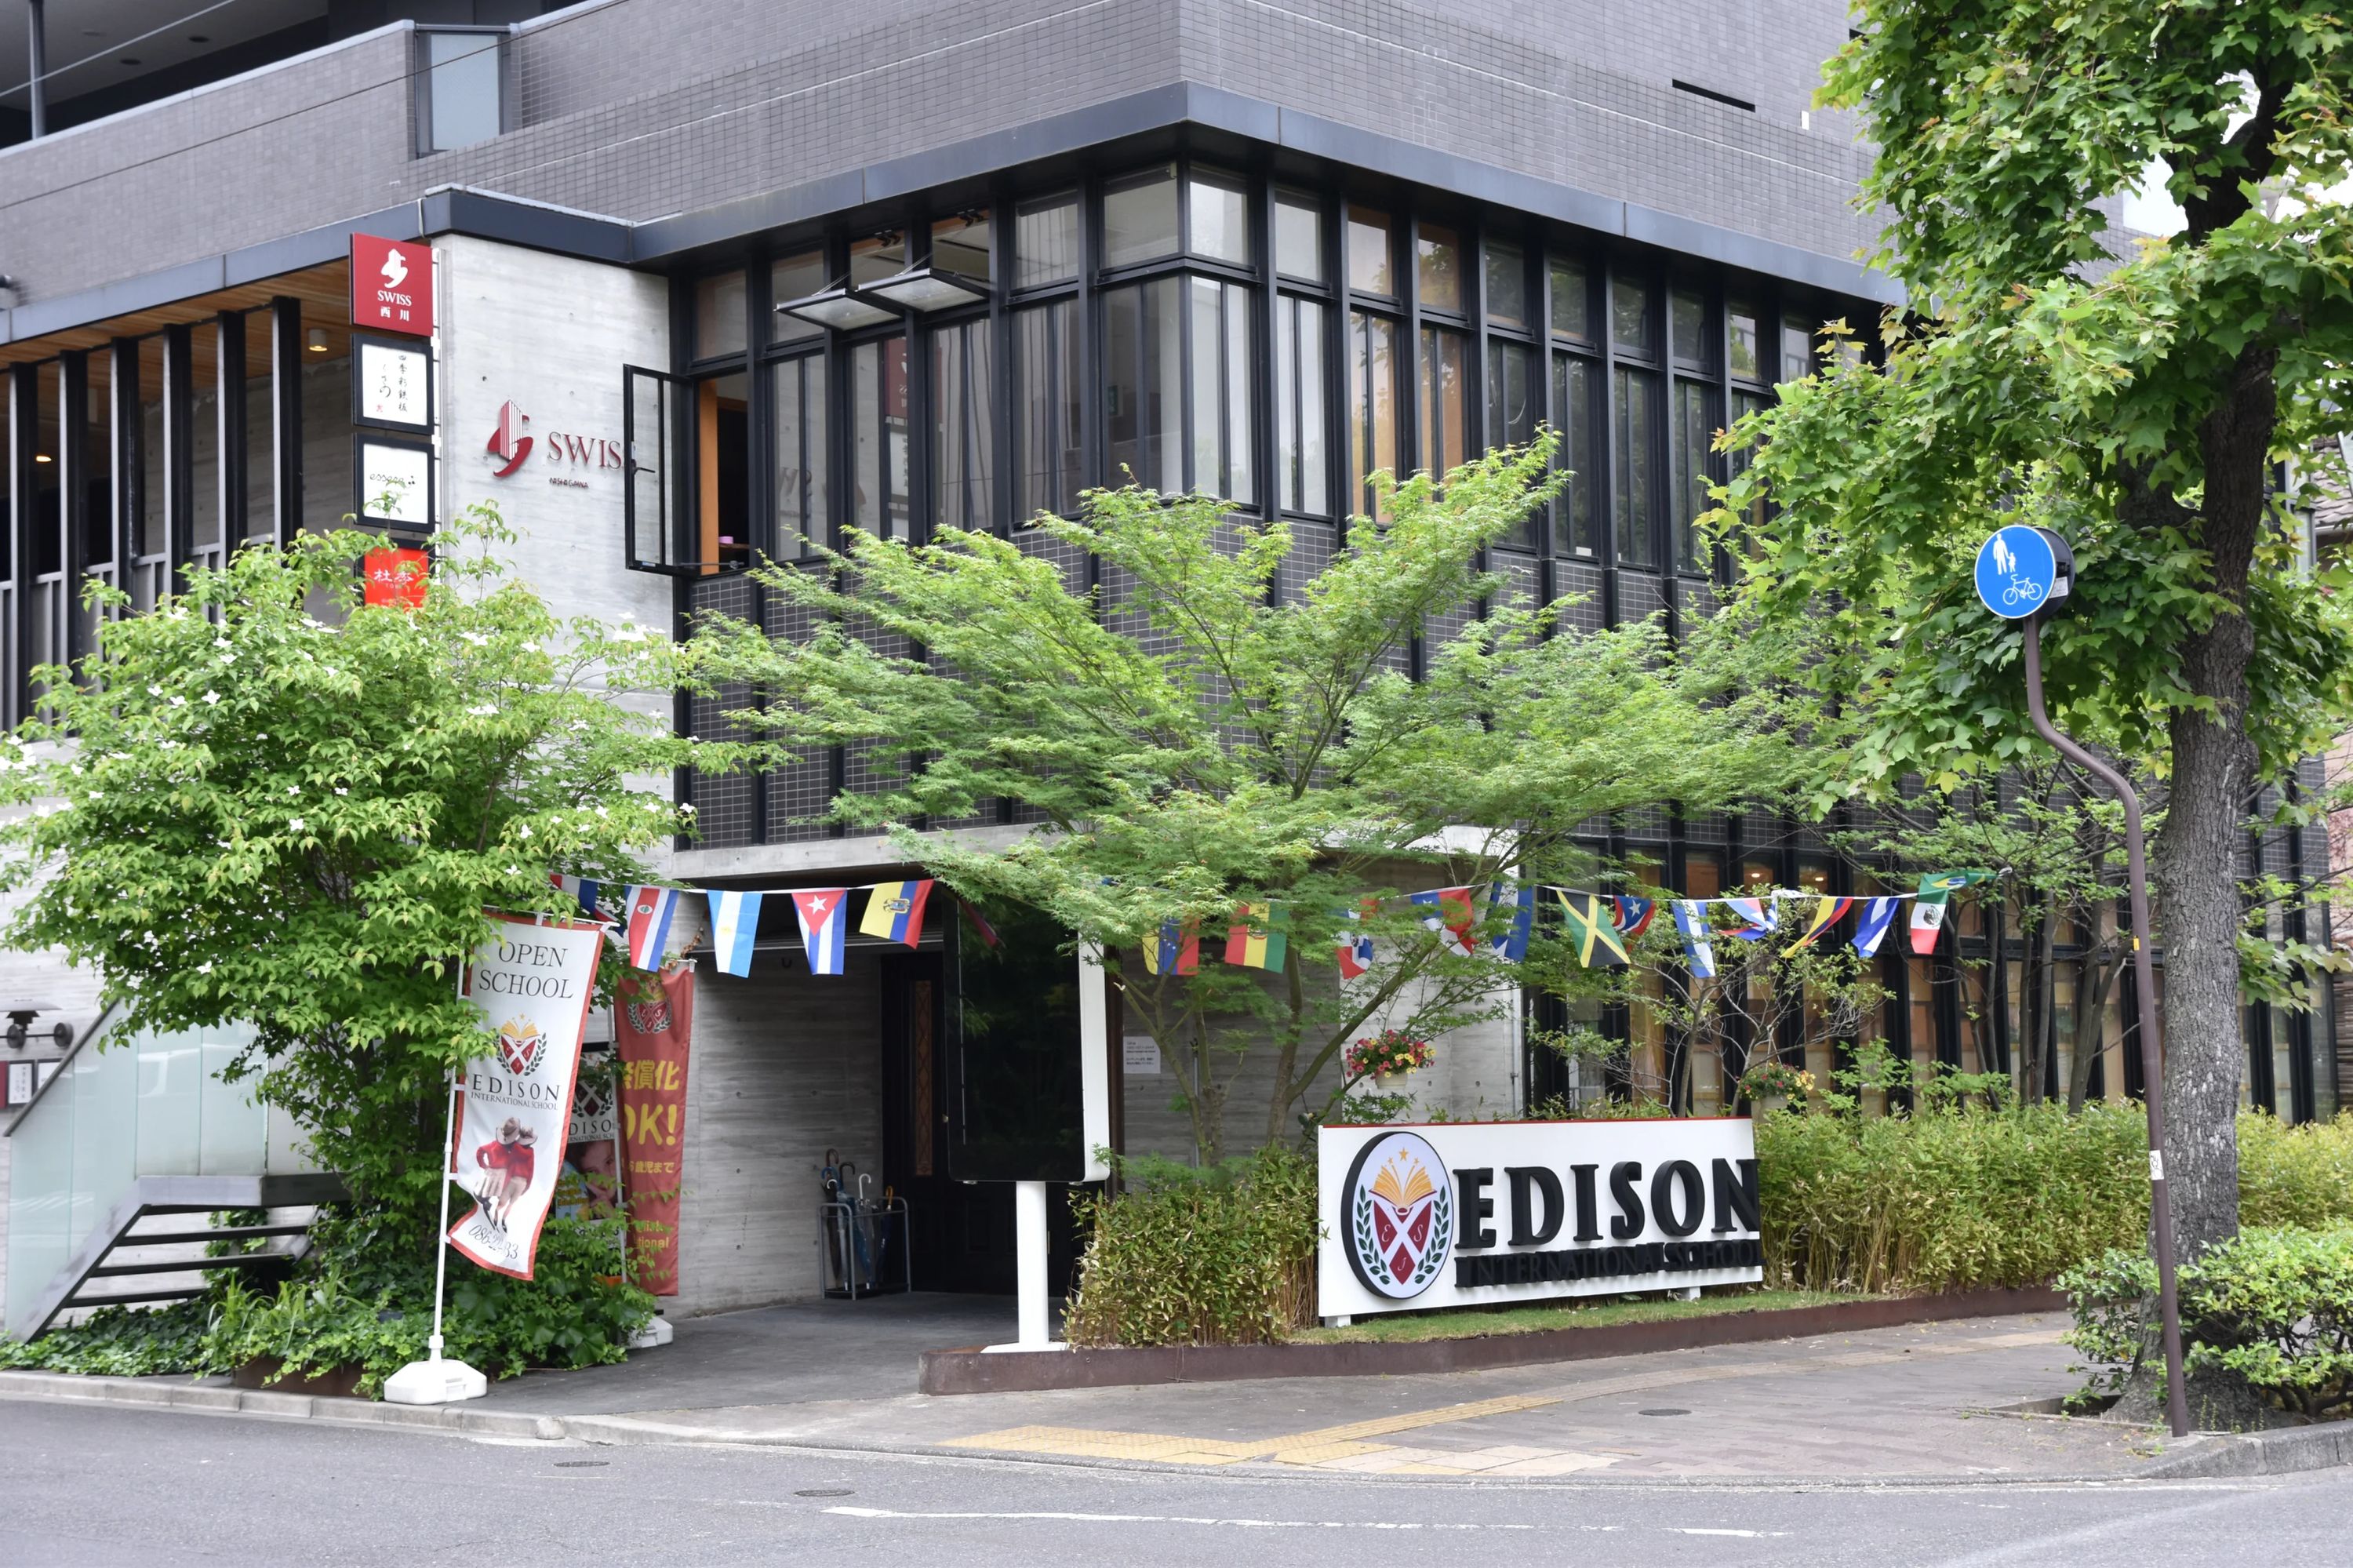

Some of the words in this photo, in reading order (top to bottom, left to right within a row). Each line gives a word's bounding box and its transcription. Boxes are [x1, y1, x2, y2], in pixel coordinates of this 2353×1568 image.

[377, 289, 412, 307] SWISS
[380, 306, 409, 322] 西川
[547, 431, 624, 470] SWIS
[498, 941, 568, 968] OPEN
[478, 970, 573, 999] SCHOOL
[472, 1074, 561, 1101] EDISON
[471, 1092, 530, 1108] INTERNATIONAL
[530, 1101, 558, 1111] SCHOOL
[569, 1119, 613, 1136] DISO
[1453, 1159, 1761, 1250] EDISON
[1454, 1242, 1667, 1288] INTERNATIONAL
[1664, 1239, 1765, 1272] SCHOOL
